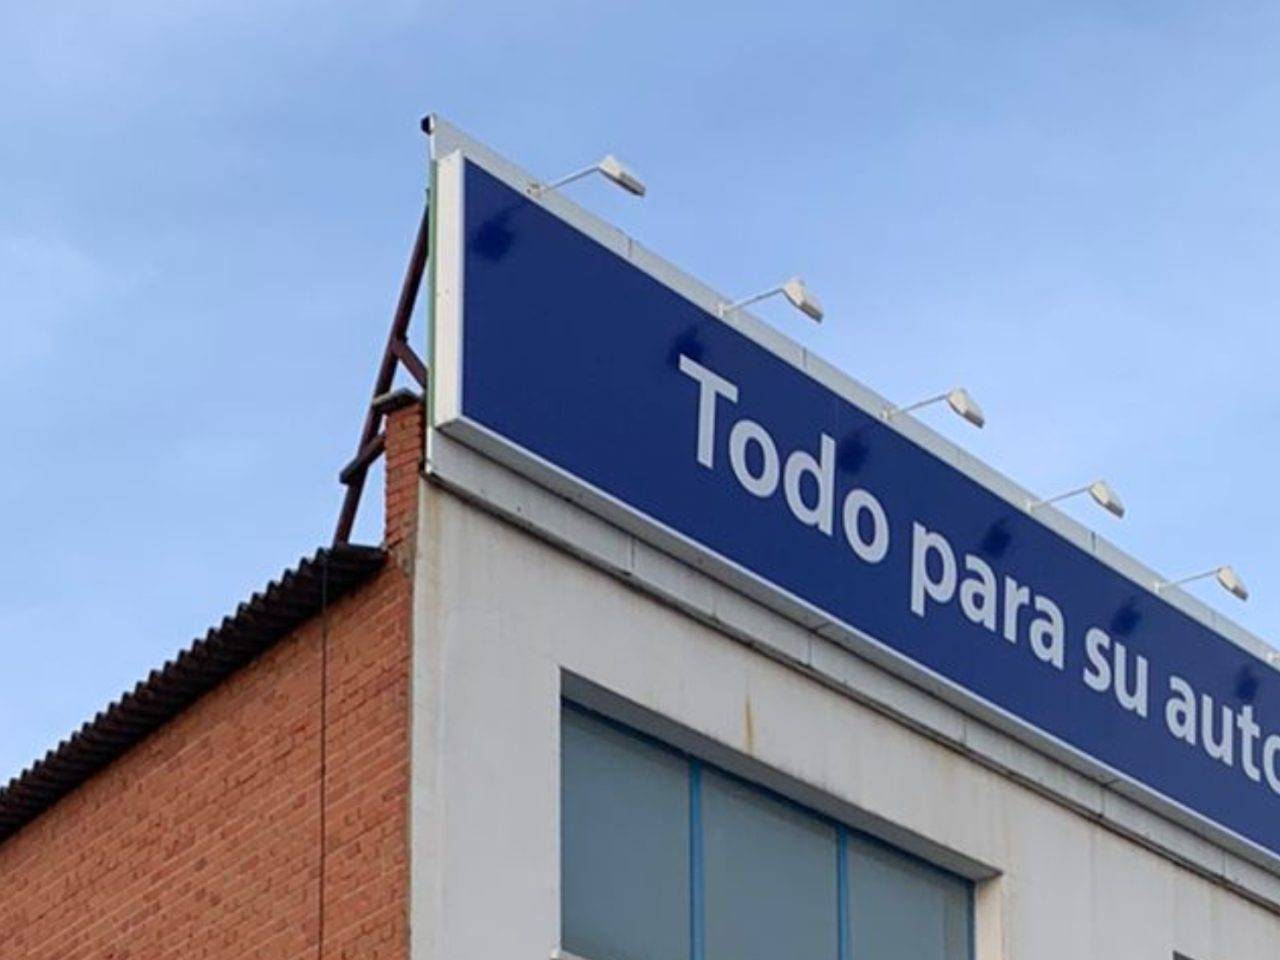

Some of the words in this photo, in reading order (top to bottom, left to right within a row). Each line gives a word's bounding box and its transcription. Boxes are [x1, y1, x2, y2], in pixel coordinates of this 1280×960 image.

[677, 353, 890, 564] Todo
[910, 520, 1065, 671] para
[1082, 627, 1149, 719] su
